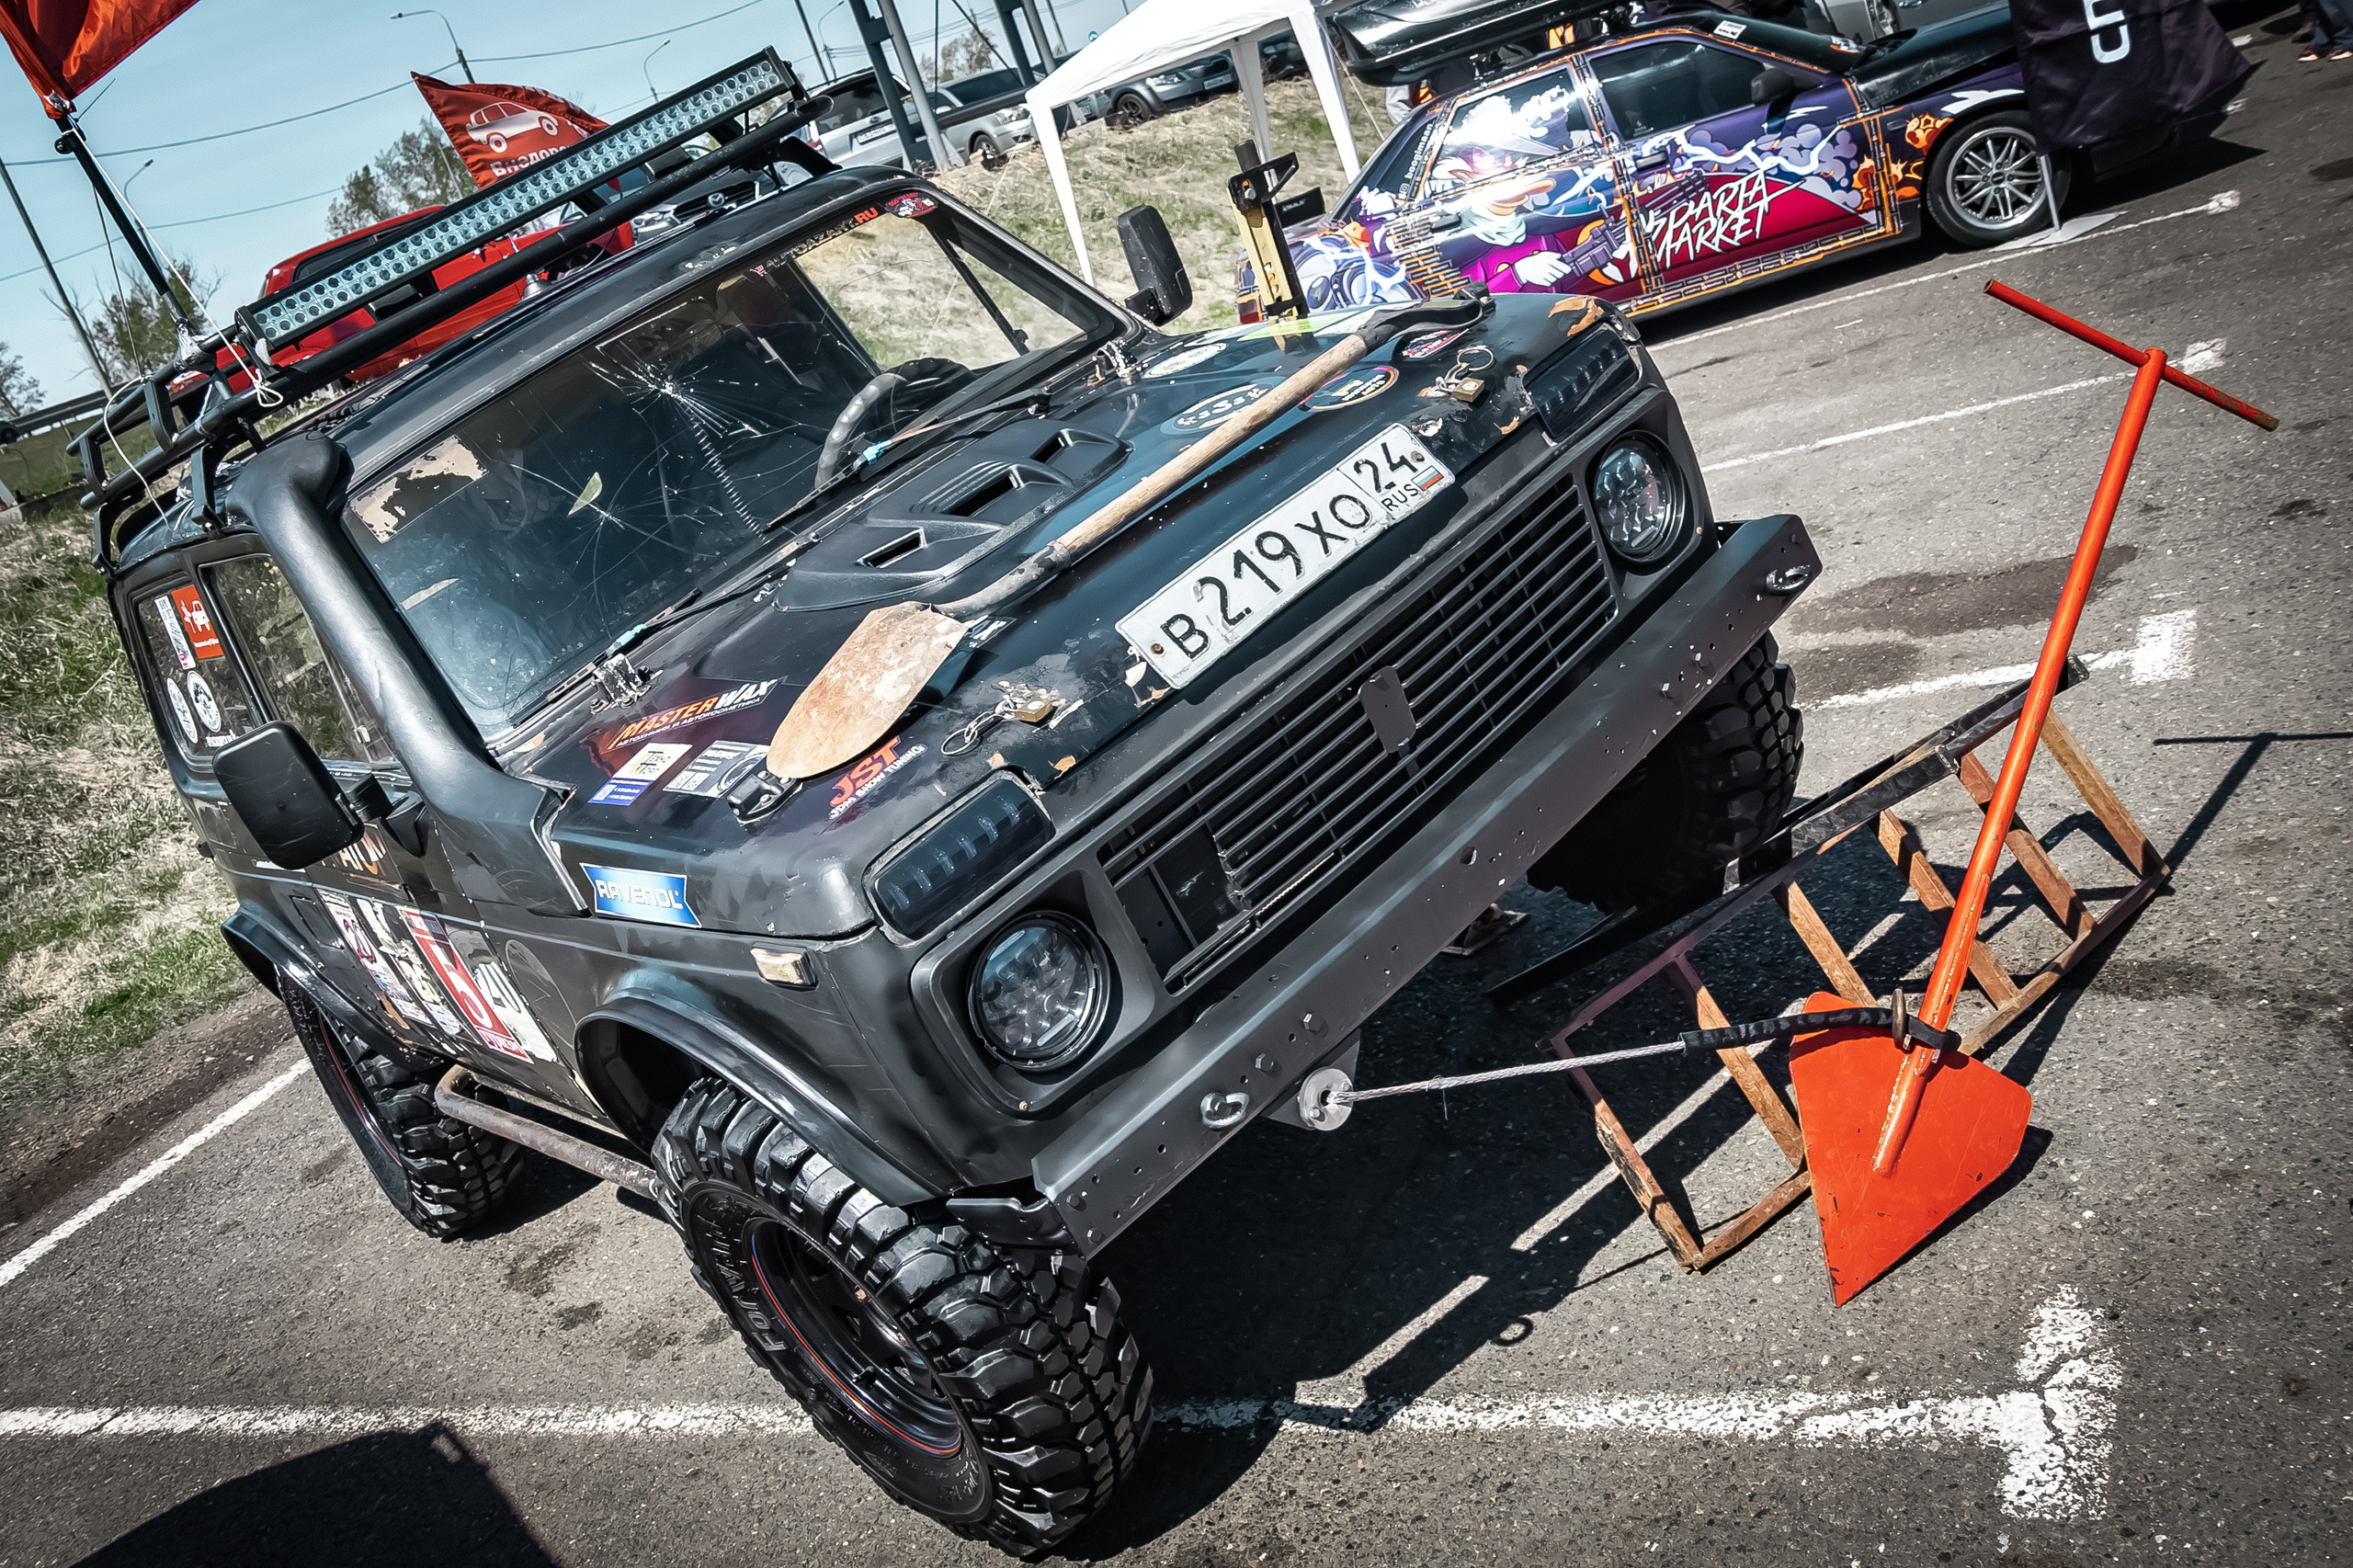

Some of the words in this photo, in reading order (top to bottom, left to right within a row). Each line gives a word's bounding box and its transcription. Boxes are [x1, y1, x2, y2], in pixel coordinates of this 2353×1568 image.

[1356, 439, 1420, 494] 24
[1381, 483, 1419, 514] RUS
[829, 796, 857, 819] JDM
[855, 771, 886, 797] SHOW
[883, 744, 926, 773] TUNING
[830, 735, 900, 806] JST
[595, 879, 684, 910] RAVENOL
